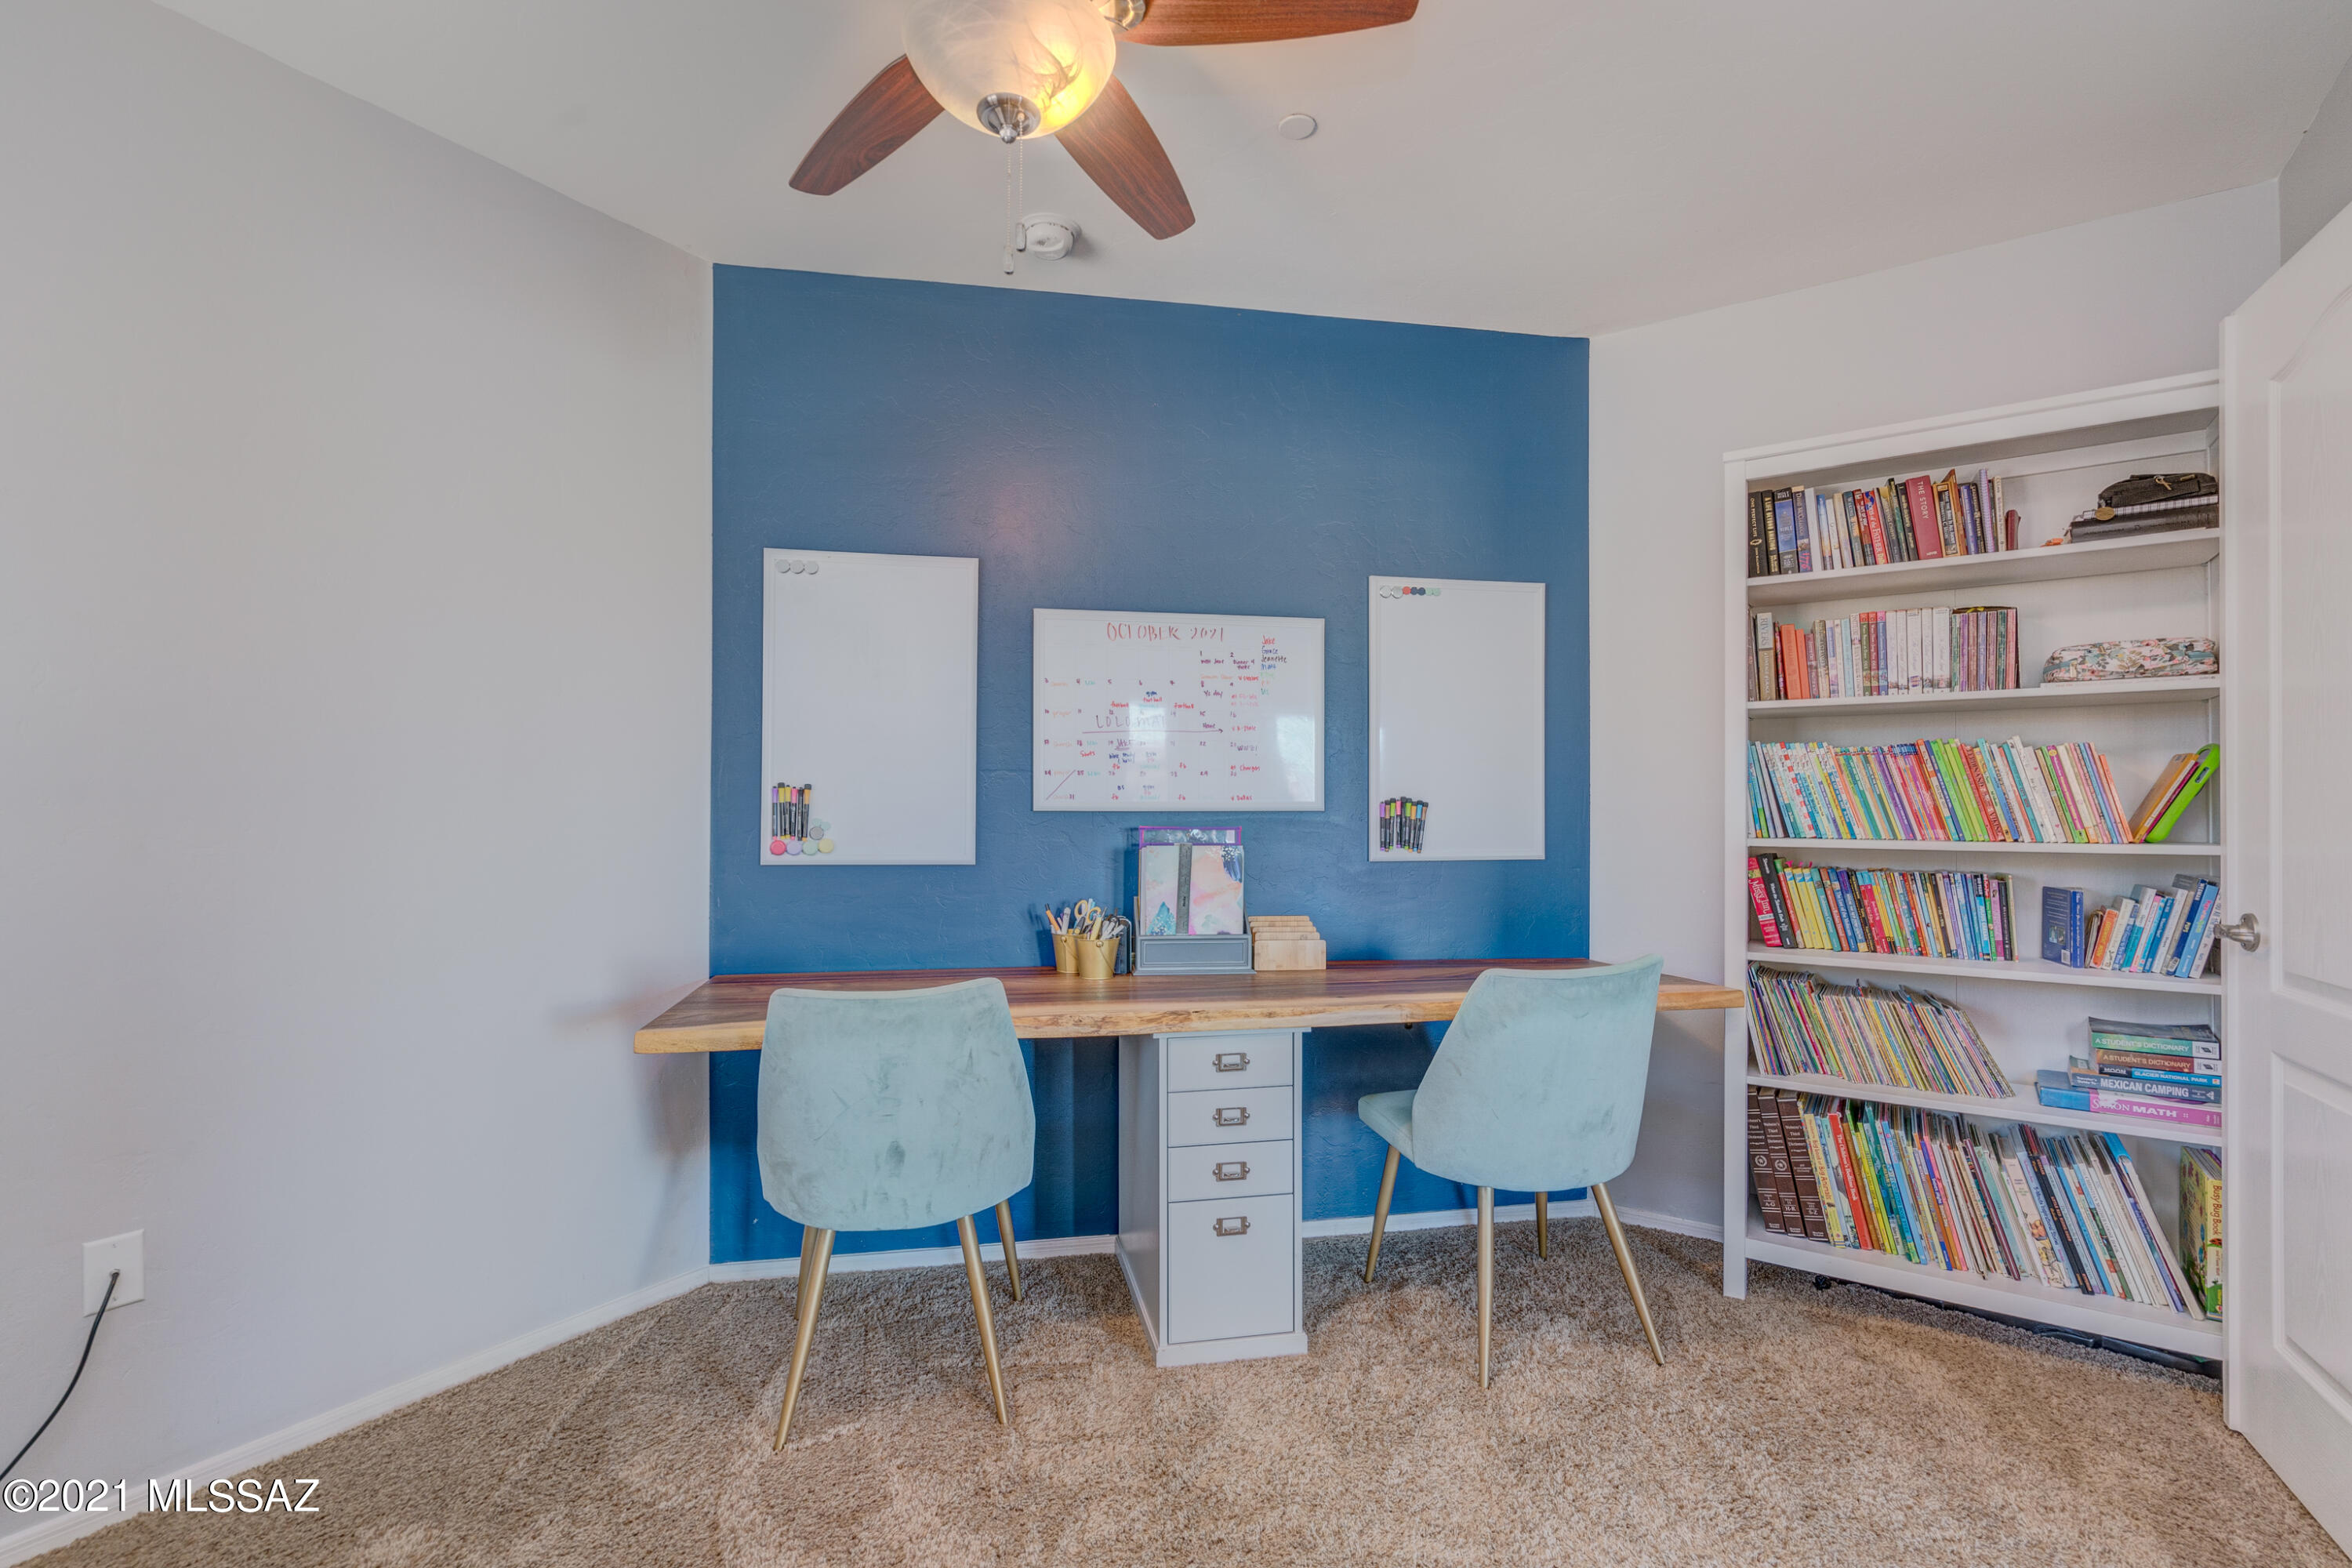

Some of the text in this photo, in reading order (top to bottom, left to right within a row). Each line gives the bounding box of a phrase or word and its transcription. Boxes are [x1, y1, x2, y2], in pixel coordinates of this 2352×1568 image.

[1916, 480, 1929, 520] THE STORY
[1766, 511, 1774, 529] BEYOND
[1767, 530, 1776, 550] AMAZING
[1798, 552, 1812, 572] 1776
[1106, 622, 1223, 641] OCTOBER 2021
[1261, 634, 1276, 644] Jake
[1759, 617, 1769, 645] RIVERS
[1261, 655, 1287, 663] Jeanette
[1965, 746, 2002, 836] FERDINAND VIKING
[1748, 877, 1771, 915] Misty Inn
[1831, 909, 1844, 938] Robin Hood
[2103, 1039, 2143, 1048] STUDENT'S
[2144, 1040, 2190, 1051] DICTIONARY
[2103, 1066, 2127, 1075] MOON
[2110, 1054, 2147, 1065] STUDENT'S
[2149, 1058, 2190, 1069] DICTIONARY
[2134, 1070, 2159, 1079] GLACIER
[2160, 1073, 2190, 1081] NATIONAL
[2100, 1078, 2190, 1097] MEXICAN CAMPING
[2132, 1105, 2177, 1118] MATH
[1838, 1143, 1849, 1170] Children's
[1844, 1168, 1854, 1189] Bedtime
[1849, 1188, 1857, 1202] Book
[1820, 1176, 1831, 1201] Animals
[2031, 1185, 2044, 1207] 5-Minute
[2038, 1205, 2054, 1234] Inspirational
[2209, 1185, 2223, 1236] Busy Bug Book
